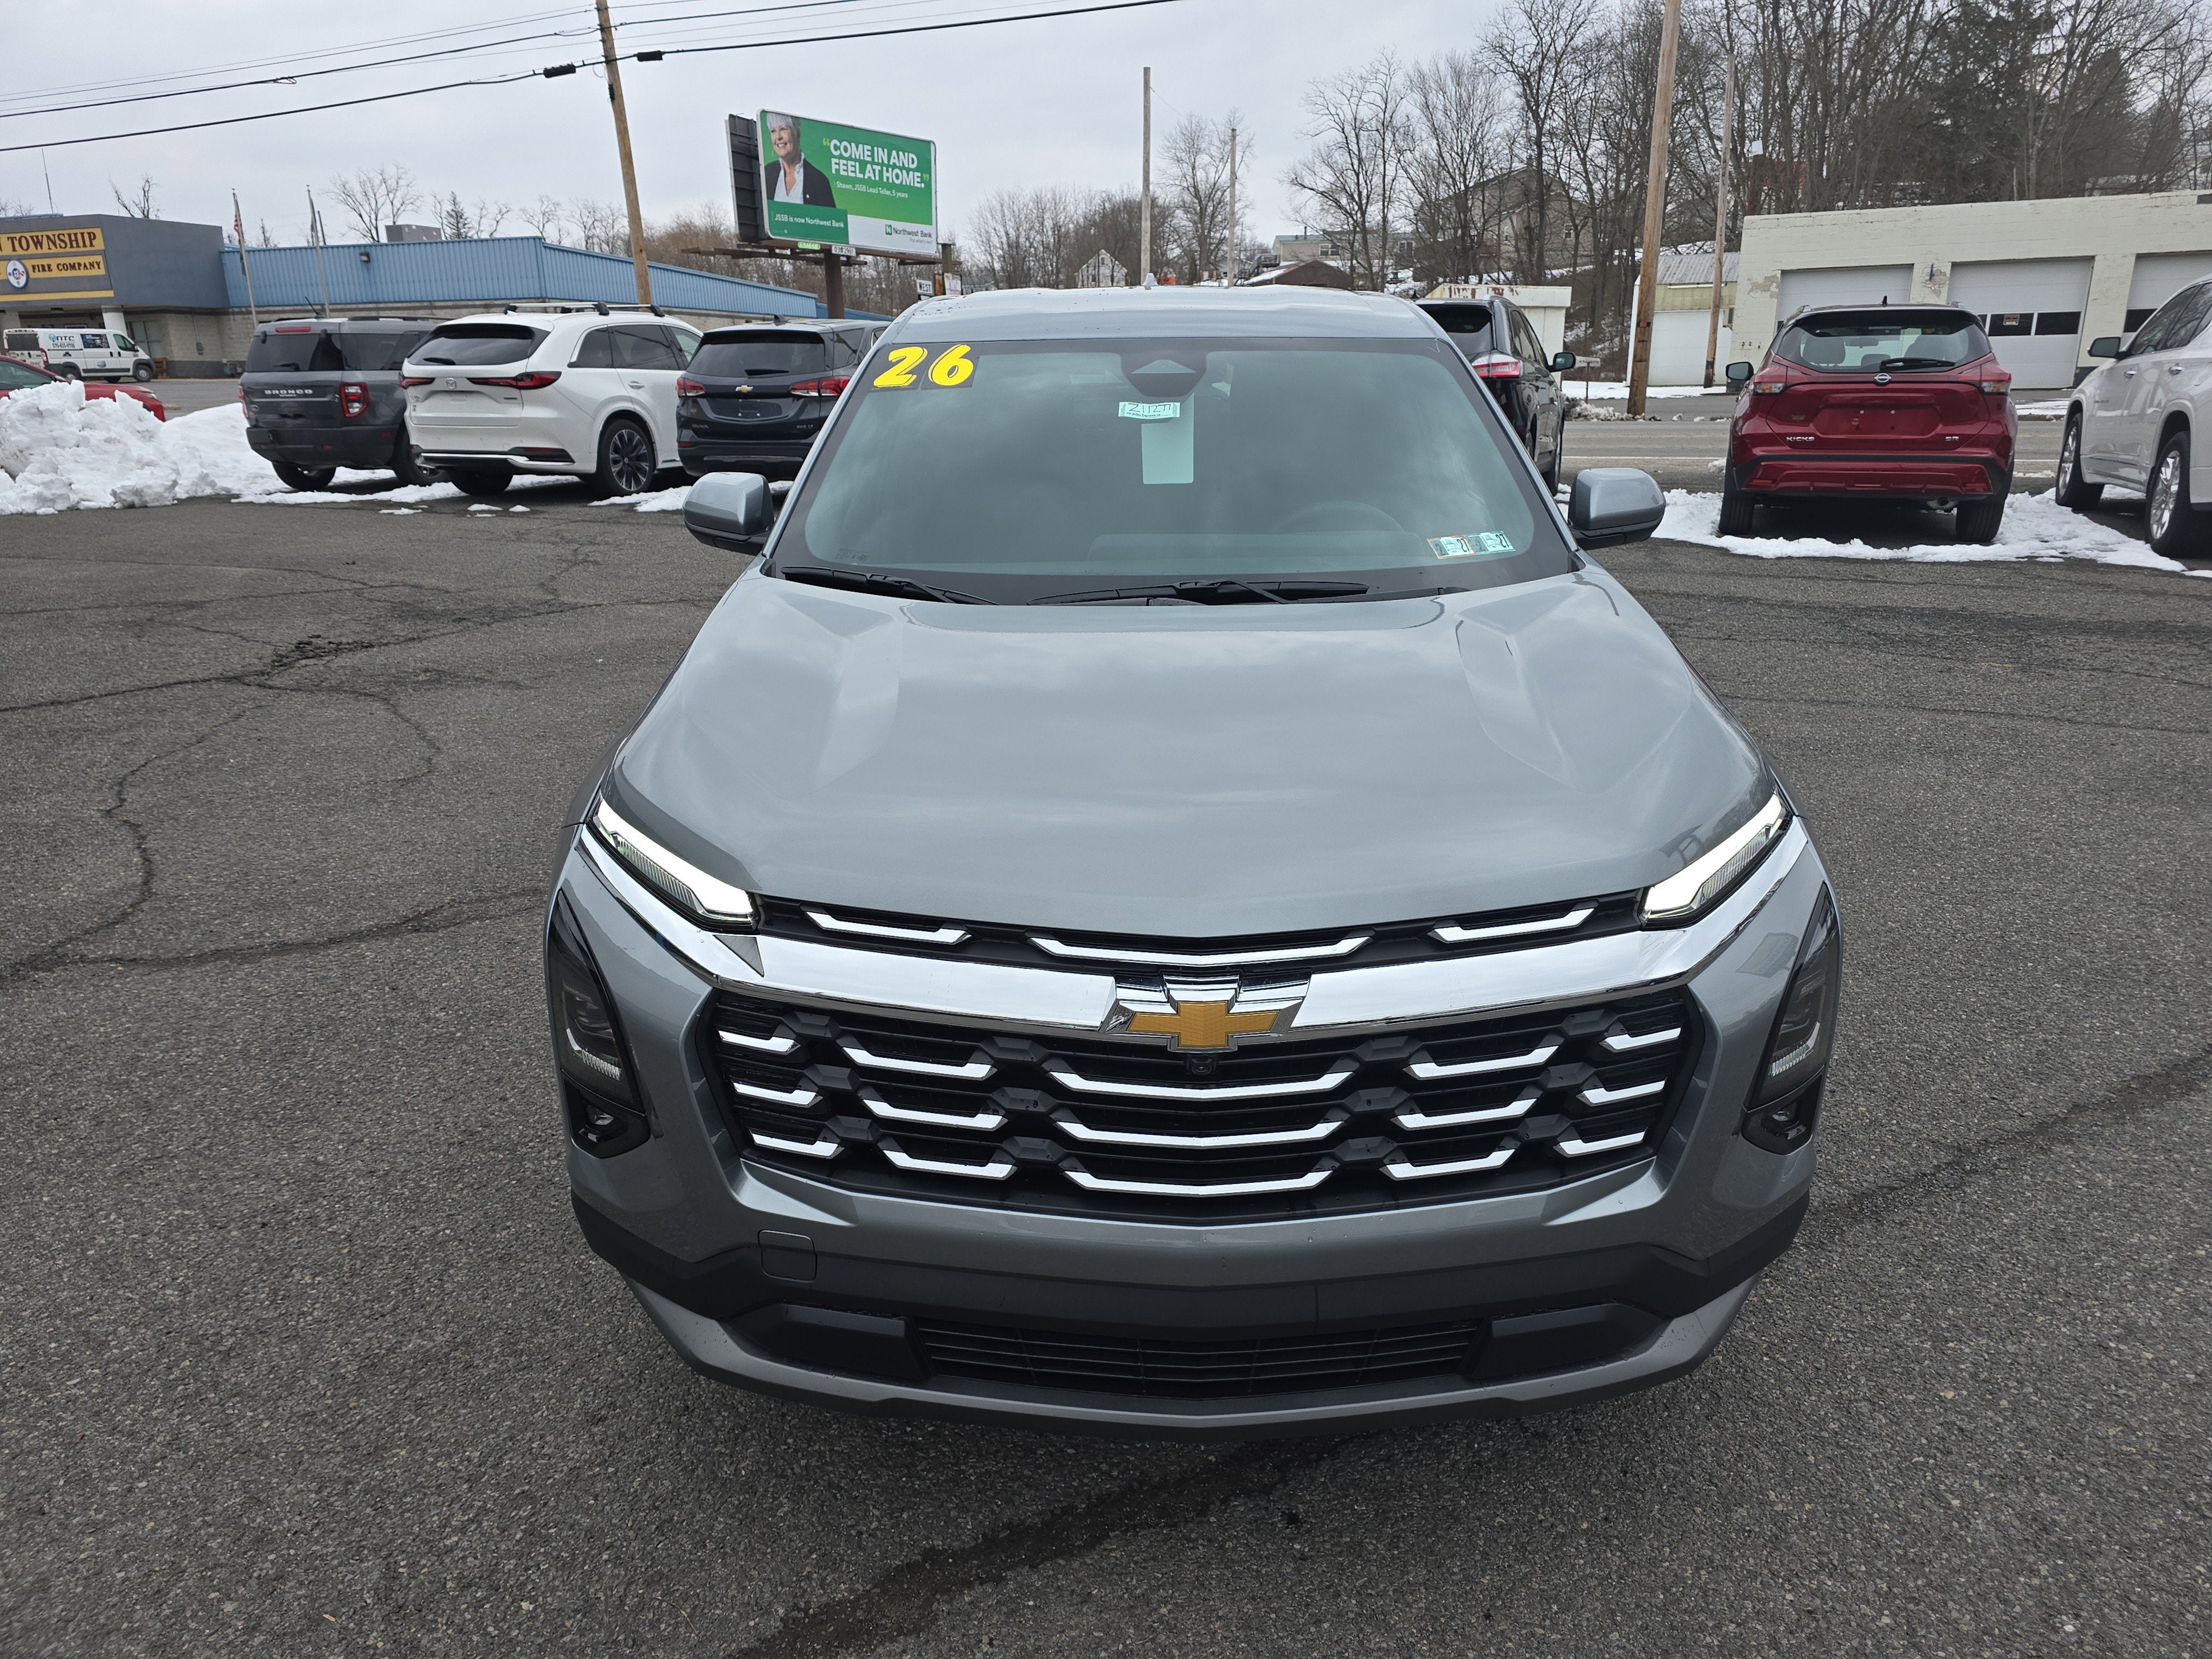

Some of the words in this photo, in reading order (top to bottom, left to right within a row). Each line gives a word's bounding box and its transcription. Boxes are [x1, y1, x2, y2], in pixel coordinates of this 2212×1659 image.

[874, 146, 888, 164] IN
[890, 150, 918, 169] AND
[831, 158, 864, 178] FEEL
[864, 164, 881, 181] AT
[805, 217, 832, 226] Northwest
[832, 220, 844, 228] Bank
[893, 227, 919, 236] Northwest
[920, 230, 932, 239] Bank
[7, 232, 97, 252] TOWNSHIP
[31, 263, 53, 273] FIRE
[56, 261, 101, 272] COMPANY
[873, 344, 974, 388] 26
[1495, 533, 1509, 548] 27
